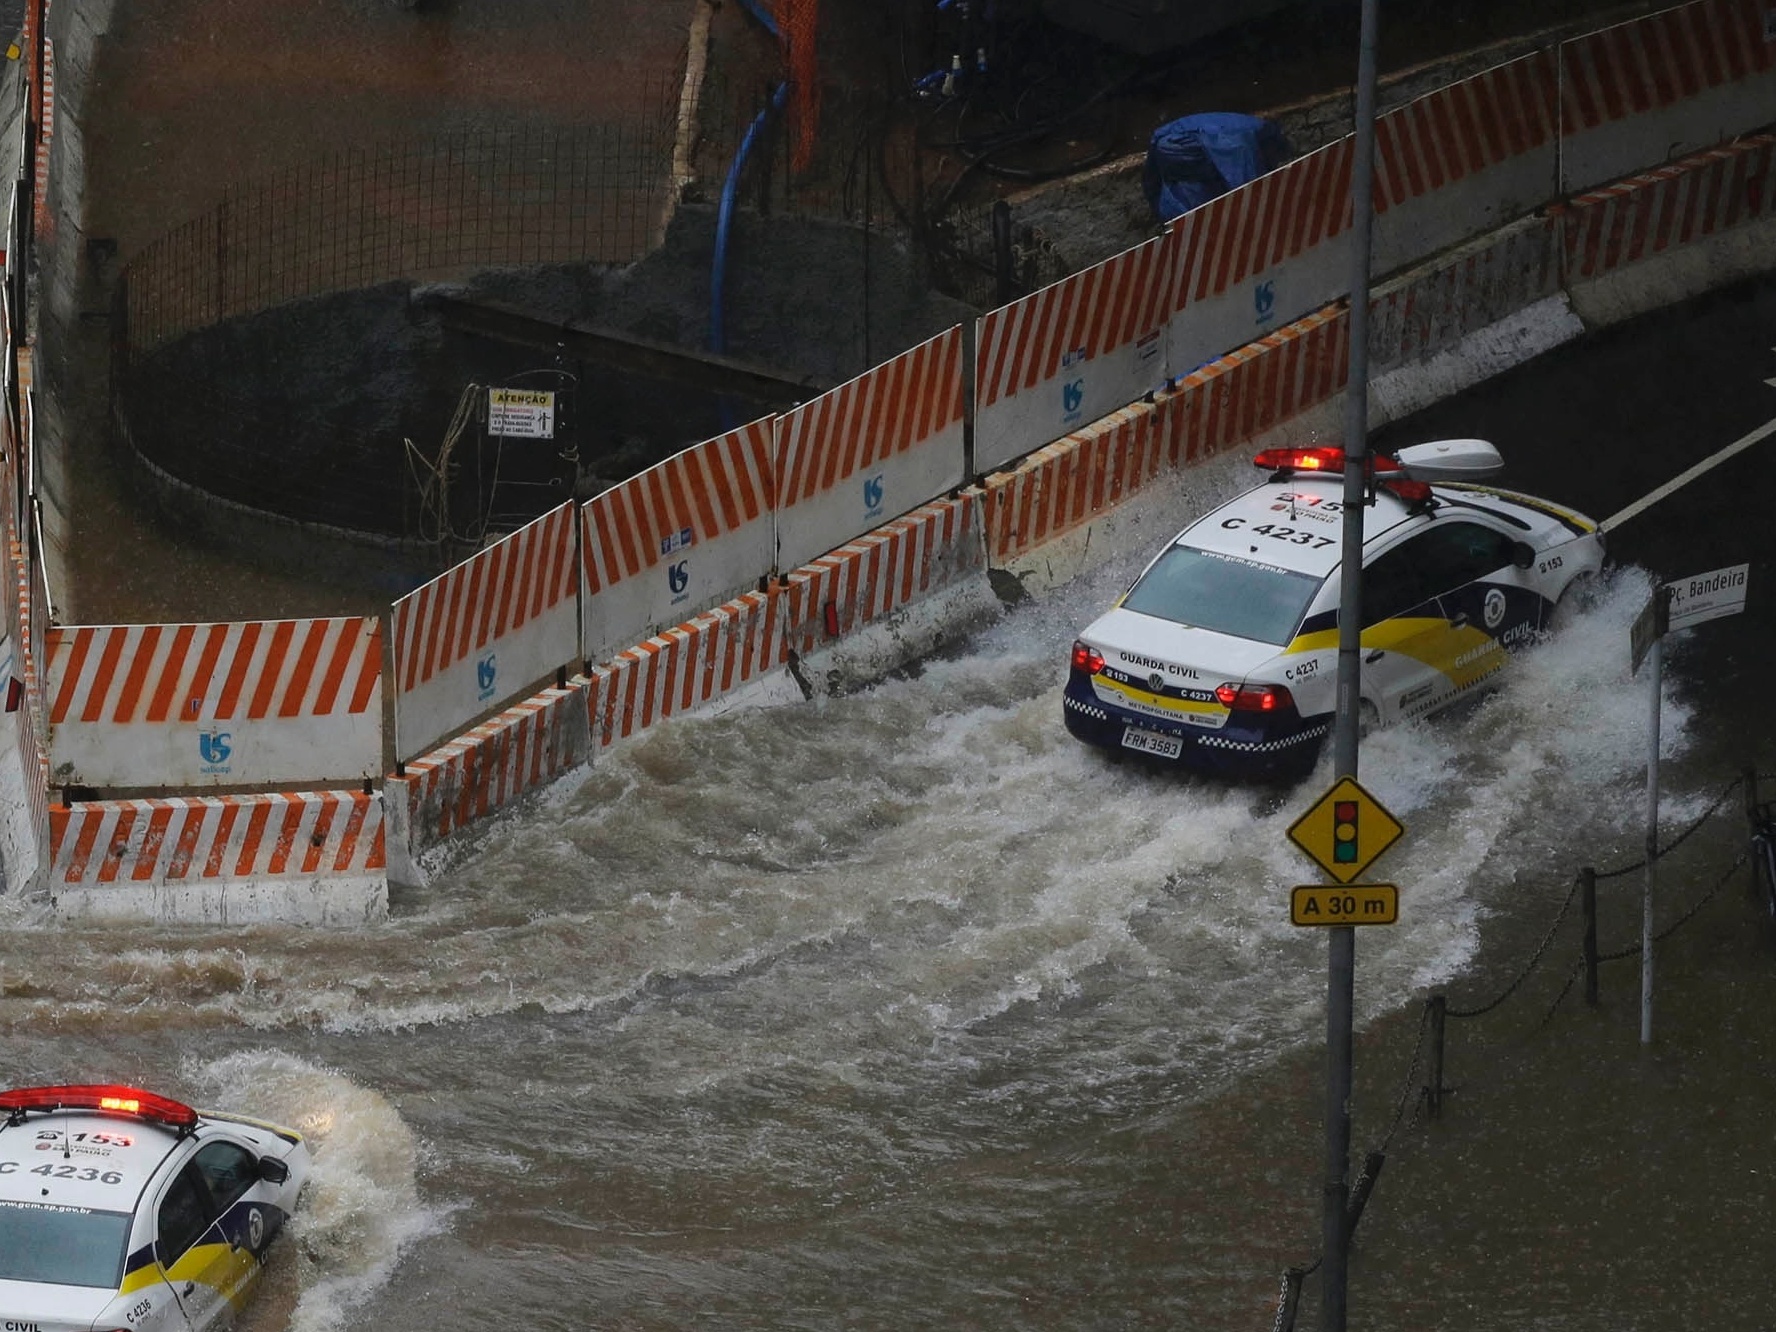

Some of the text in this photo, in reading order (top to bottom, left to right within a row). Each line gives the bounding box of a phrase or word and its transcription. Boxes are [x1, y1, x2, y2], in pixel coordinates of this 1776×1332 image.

[1221, 518, 1336, 549] C 4237
[1548, 556, 1563, 570] 153
[1689, 570, 1745, 598] Bandeira
[1120, 651, 1200, 680] GUARDA CIVIL
[1285, 669, 1294, 681] C
[1295, 659, 1320, 676] 4237
[1112, 670, 1129, 683] 153
[1180, 689, 1212, 701] C 4237
[1128, 701, 1184, 720] METROPOLITANA
[1303, 896, 1385, 915] A 30 m
[72, 1133, 132, 1148] 153
[30, 1164, 124, 1185] 4236
[126, 1312, 135, 1323] C
[134, 1299, 152, 1318] 4236
